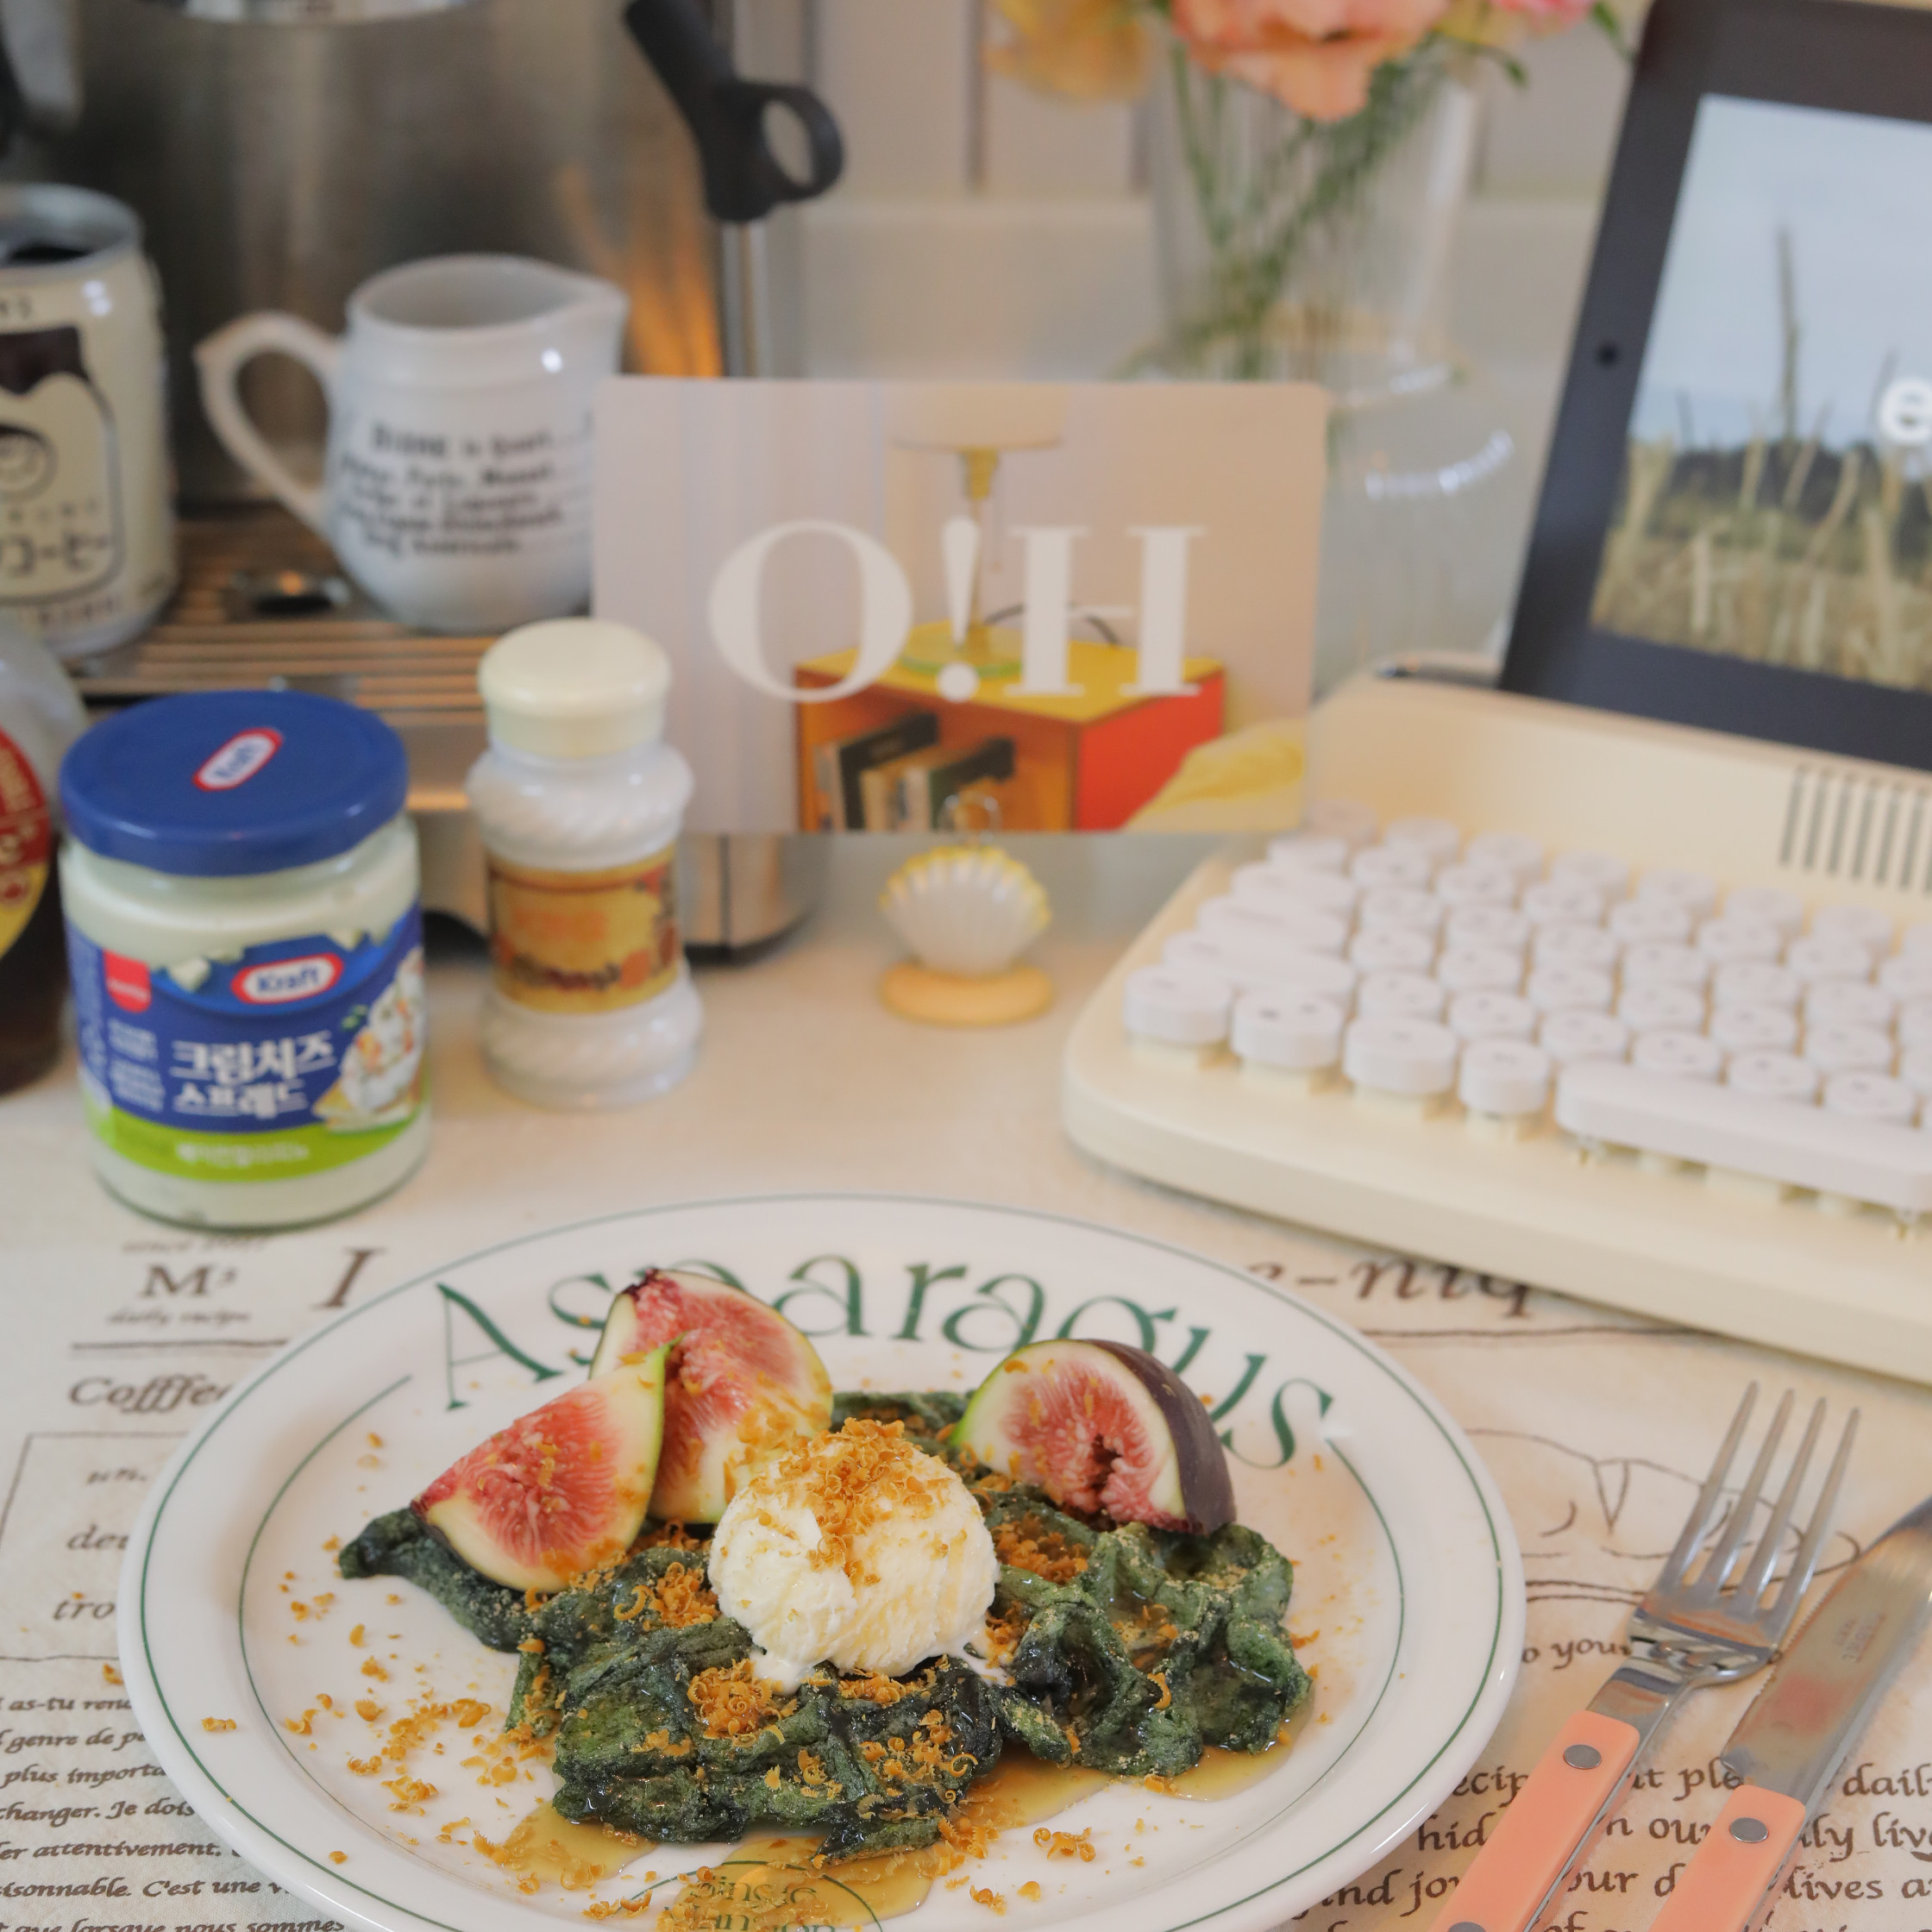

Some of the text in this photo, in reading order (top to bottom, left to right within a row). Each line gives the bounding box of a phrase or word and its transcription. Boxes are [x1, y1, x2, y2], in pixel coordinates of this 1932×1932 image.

[257, 967, 319, 991] Kraft
[168, 1030, 337, 1085] 크림치즈
[173, 1078, 308, 1120] 스프레드
[53, 1599, 116, 1621] tro
[1521, 1647, 1540, 1663] o
[9, 1697, 75, 1711] as-tu
[4, 1734, 78, 1754] genre
[85, 1727, 115, 1746] de
[0, 1763, 166, 1789] plus importa
[1452, 1765, 1529, 1808] ecip
[1672, 1756, 1744, 1802] ple
[1842, 1762, 1932, 1797] dail
[104, 1800, 138, 1819] Je
[144, 1797, 196, 1816] dois
[1418, 1811, 1496, 1851] hid
[1872, 1811, 1932, 1848] liv
[32, 1840, 222, 1858] attentivement.
[141, 1879, 206, 1898] C'est
[211, 1880, 261, 1894] une
[1786, 1866, 1884, 1900] lives
[246, 1918, 345, 1932] sommes
